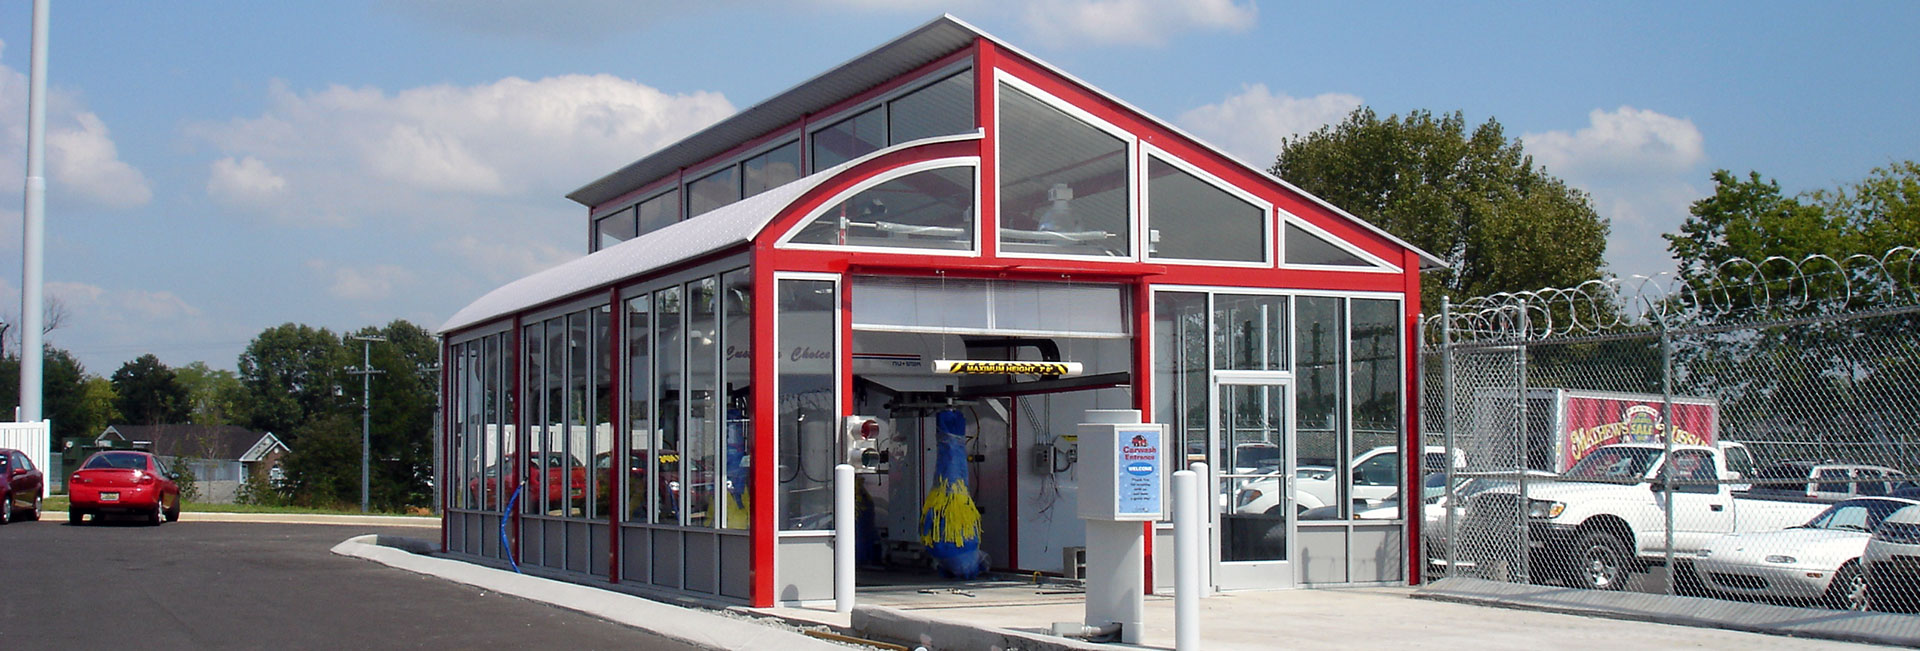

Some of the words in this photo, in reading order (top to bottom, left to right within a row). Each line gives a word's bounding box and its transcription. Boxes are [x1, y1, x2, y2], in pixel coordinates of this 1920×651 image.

[791, 346, 831, 361] Choice
[1006, 365, 1035, 373] HEIGHT
[1631, 423, 1653, 433] SALE
[1570, 421, 1629, 459] MATHEWS
[1123, 446, 1156, 454] Carwash
